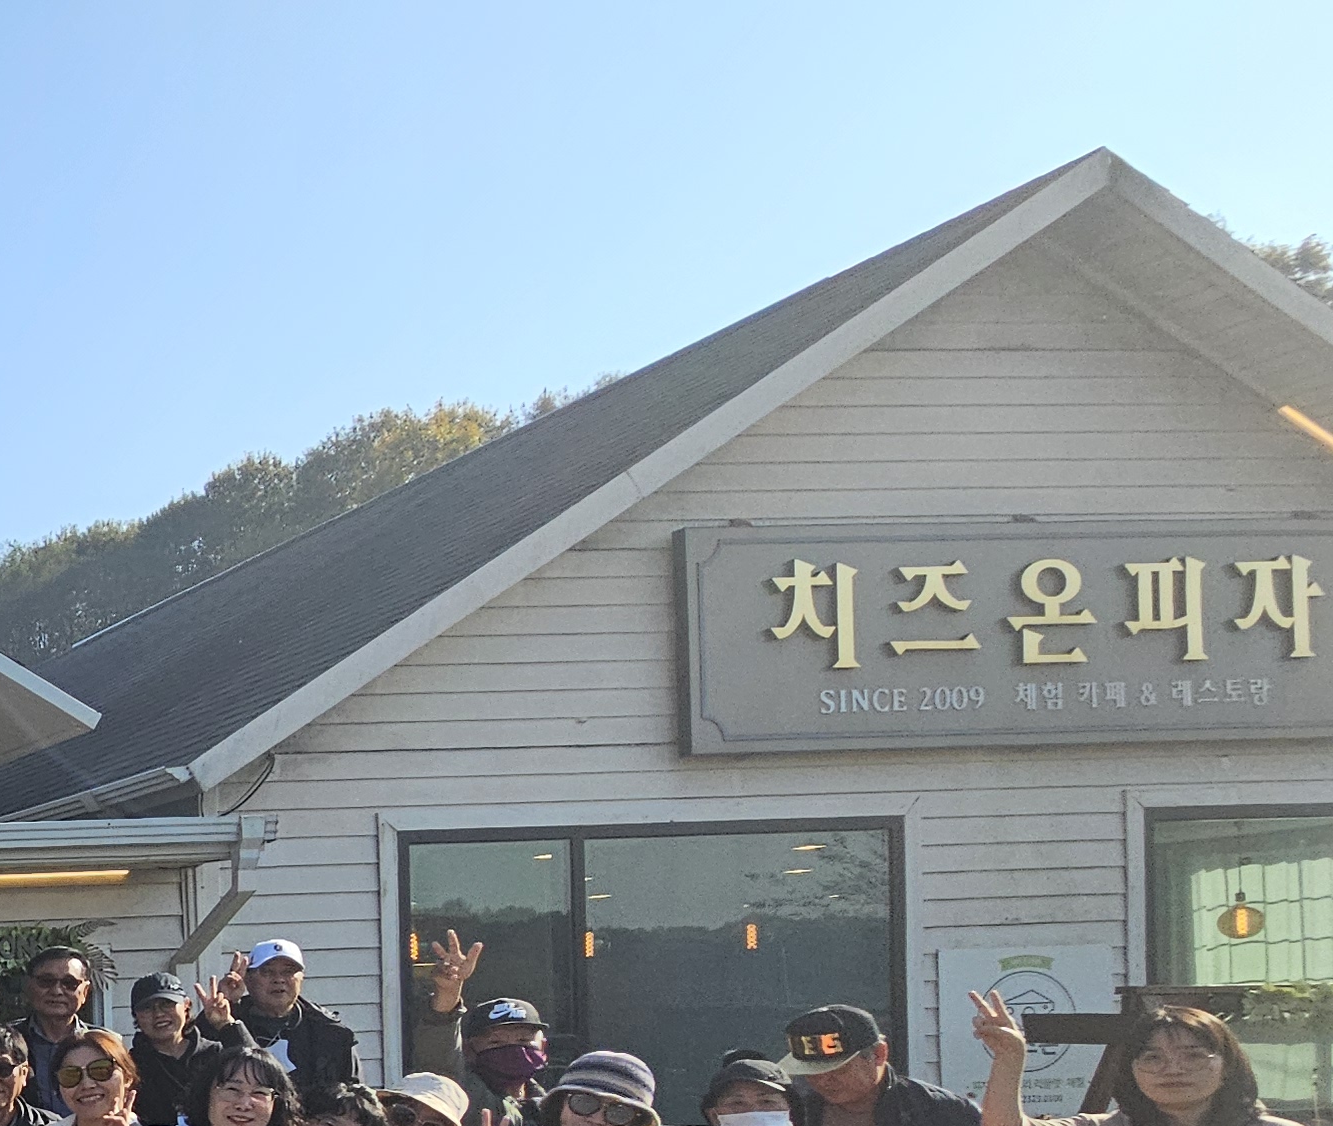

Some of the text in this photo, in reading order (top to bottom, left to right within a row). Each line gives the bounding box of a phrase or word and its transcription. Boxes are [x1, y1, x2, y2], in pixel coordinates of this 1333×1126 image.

[769, 554, 1326, 668] 치즈온피자
[819, 677, 1273, 714] SINCE 2009 체험 카페 & 레스토랑
